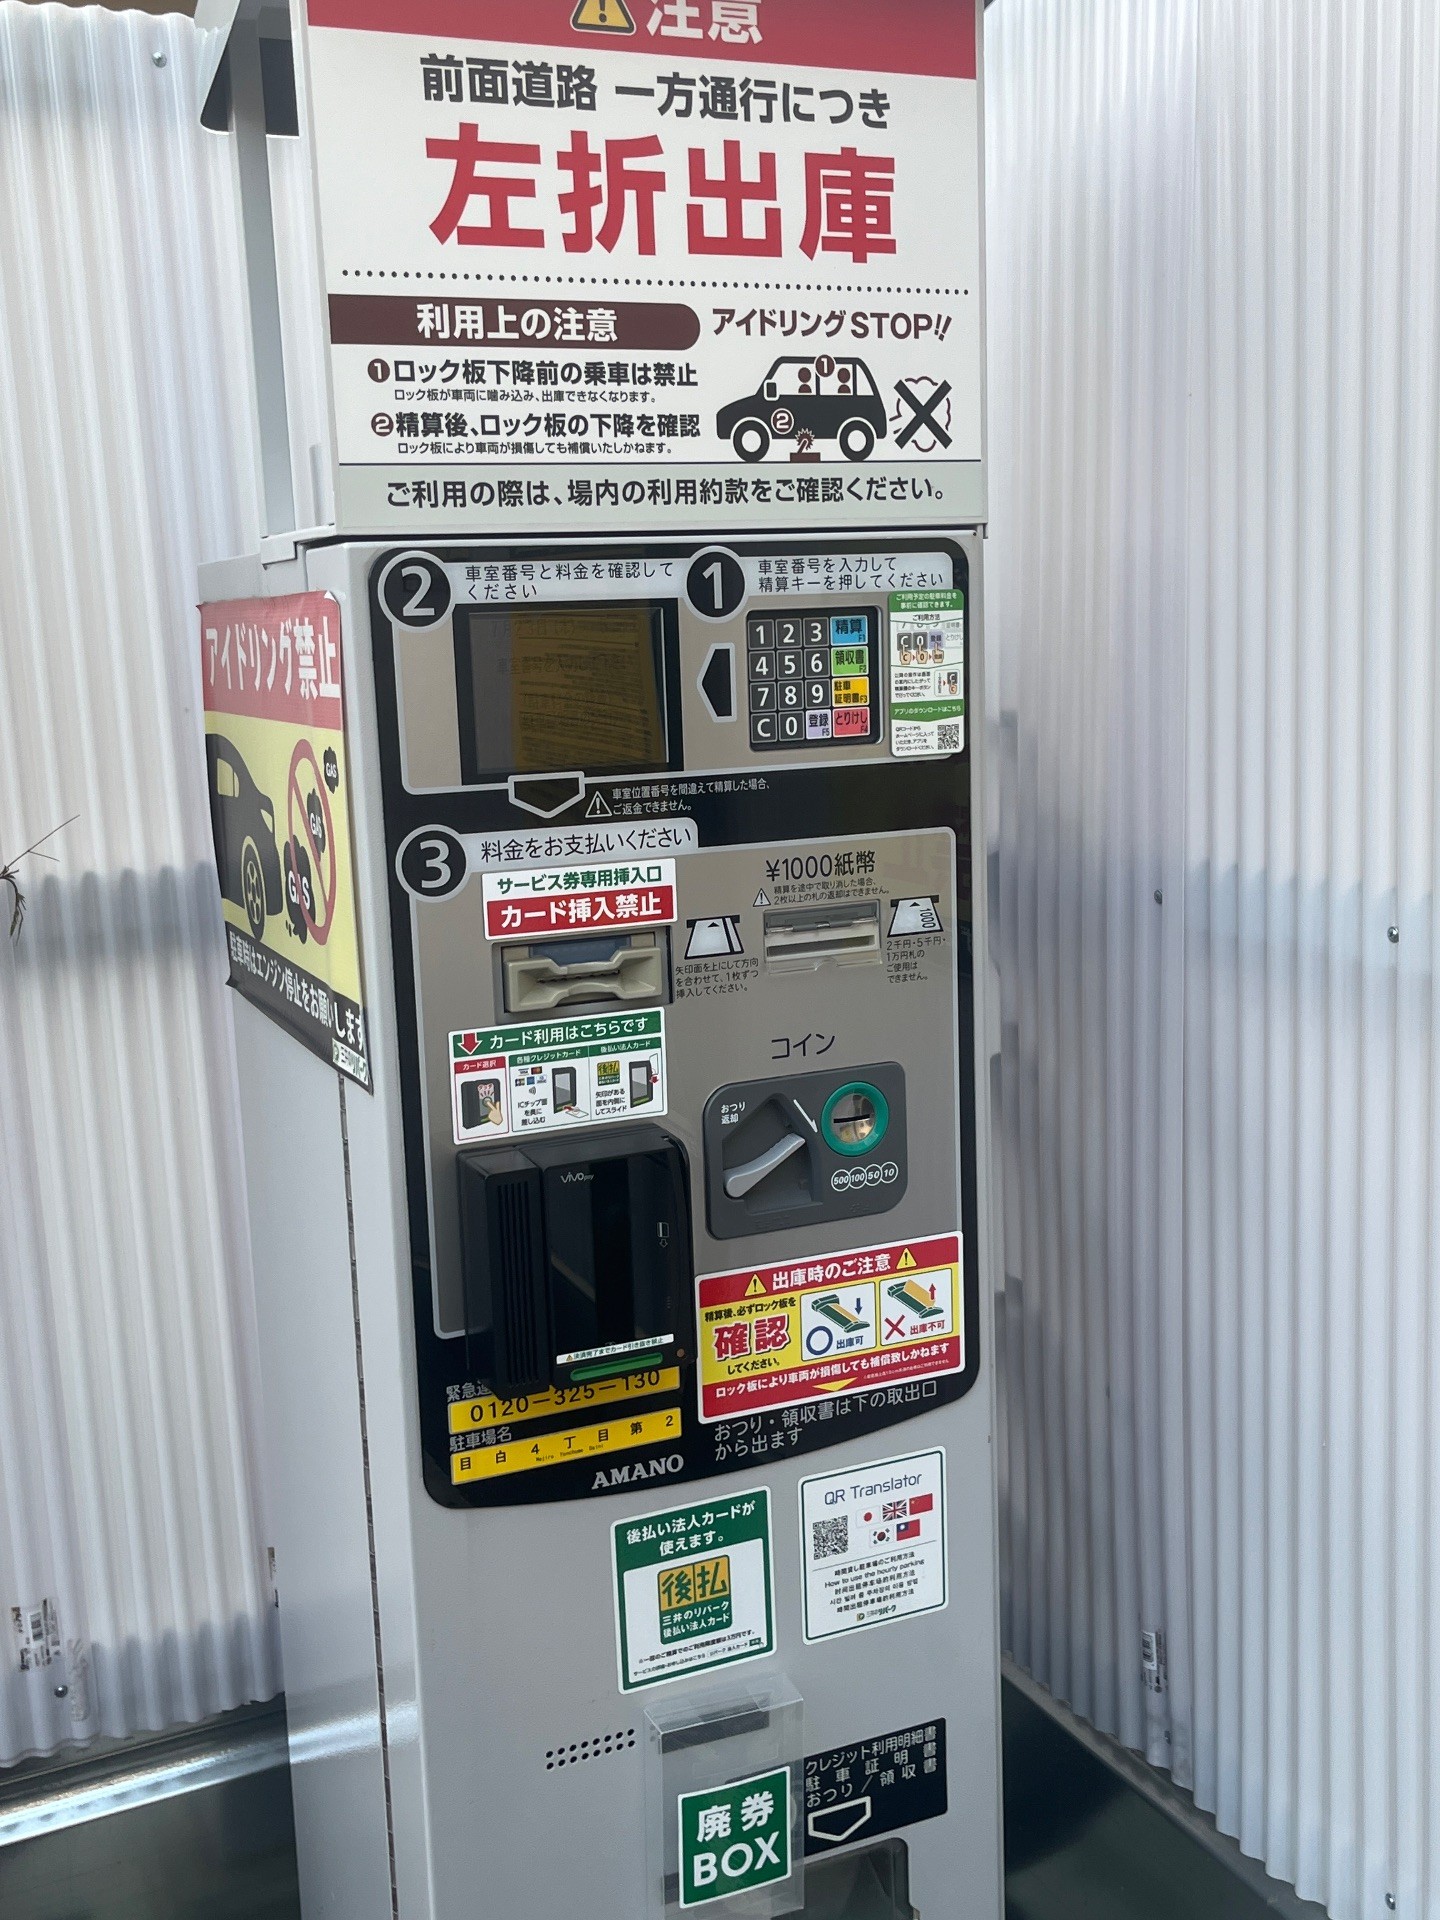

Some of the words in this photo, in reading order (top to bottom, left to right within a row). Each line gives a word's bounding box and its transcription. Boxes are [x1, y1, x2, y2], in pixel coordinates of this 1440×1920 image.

[646, 0, 763, 45] 注意
[419, 53, 598, 112] 前面道路
[615, 72, 891, 129] 一方通行につき
[425, 122, 898, 264] 左折出庫
[416, 303, 619, 342] 利用上の注意
[394, 388, 656, 404] ロック板が車両に噛み込み、出庫できなくなります。
[398, 441, 673, 455] ロック板により車両が損傷しても補償いたしかねます。
[387, 477, 943, 508] ご利用の際は、場内の利用約款をご確認ください。
[465, 562, 674, 581] 車室番号と料金を確認して
[758, 557, 897, 575] 車室番号を入力して
[401, 565, 435, 617] 2
[467, 583, 537, 600] ください
[702, 562, 724, 610] 1
[758, 573, 943, 593] 精算キーを押してください
[756, 625, 764, 644] 1
[783, 624, 795, 643] 2
[811, 623, 822, 642] 3
[835, 618, 862, 634] 精算
[206, 615, 341, 699] アイドリング禁止
[756, 657, 768, 675] 4
[784, 655, 795, 674] 5
[811, 653, 823, 673] 6
[835, 649, 865, 666] 領収書
[758, 687, 769, 707] 7
[785, 686, 797, 705] 8
[812, 684, 824, 703] 9
[757, 718, 771, 738] C
[785, 717, 798, 736] 0
[808, 713, 829, 727] 登録
[835, 712, 868, 726] とりけし
[326, 763, 337, 778] GAS
[612, 778, 770, 800] 車室位置番号を間違えて精算した場合、
[613, 799, 691, 815] ご返金できません。
[309, 812, 322, 839] GAS
[481, 826, 691, 863] 料金をお支払いください
[419, 839, 451, 889] 3
[766, 850, 876, 881] ¥1000紙幣
[497, 865, 662, 895] サービス券専用挿入口
[501, 892, 662, 928] カード挿入禁止
[920, 908, 936, 928] 1000
[886, 949, 925, 961] 1万円札の
[675, 958, 759, 975] 矢印面を上にして方向
[886, 961, 918, 972] ご使用は
[675, 970, 759, 987] を合わせて、1枚ずつ
[887, 972, 928, 983] できません。
[676, 983, 748, 999] 挿入してください。
[489, 1017, 649, 1049] カード利用はこちらです
[771, 1033, 836, 1059] コイン
[463, 1060, 497, 1070] カード選択
[595, 1105, 627, 1115] してスライド
[721, 1101, 746, 1113] おつり
[721, 1113, 739, 1125] 返却
[833, 1174, 849, 1185] 500
[851, 1172, 865, 1182] 100
[772, 1253, 891, 1291] 出庫時のご注意
[705, 1297, 797, 1322] 精算後、必ずロック板を
[714, 1314, 790, 1361] 確認
[909, 1319, 946, 1336] 出庫不可
[836, 1335, 864, 1350] 出庫可
[715, 1343, 949, 1399] ロック板により車両が損傷しても補償致しかねます
[728, 1357, 780, 1375] してください。
[714, 1380, 938, 1442] おつり・領収書は下の取出口
[449, 1426, 512, 1453] 駐車場名
[714, 1427, 803, 1462] から出ます
[591, 1454, 684, 1490] AMANO
[824, 1488, 846, 1505] QR
[850, 1473, 922, 1500] Translator
[626, 1500, 756, 1544] 後払い法人カードが
[659, 1530, 724, 1557] 使えます。
[824, 1580, 840, 1588] How
[877, 1566, 899, 1575] hourly
[899, 1559, 925, 1570] parking
[661, 1562, 728, 1607] 後払
[662, 1601, 729, 1626] 三井のリパーク
[663, 1613, 730, 1638] 後払い法人カード
[805, 1725, 937, 1776] クレジット利用明細書
[697, 1790, 774, 1843] 廃券
[693, 1831, 780, 1887] BOX
